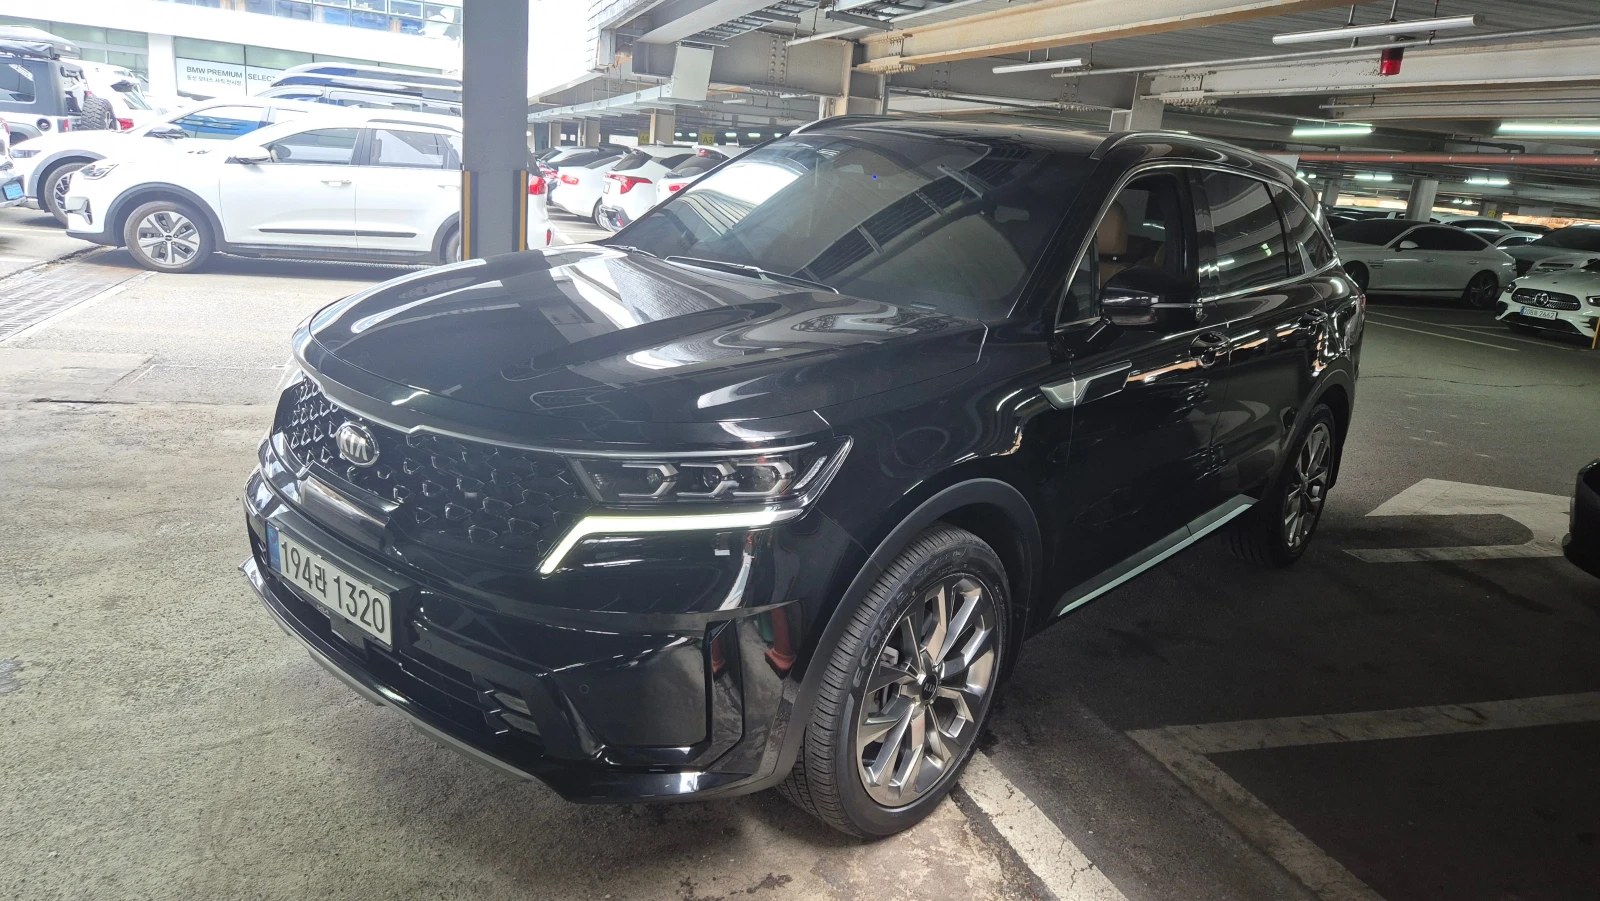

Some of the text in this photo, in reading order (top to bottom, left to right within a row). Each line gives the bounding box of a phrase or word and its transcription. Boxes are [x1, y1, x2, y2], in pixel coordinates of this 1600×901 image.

[187, 66, 205, 74] BMW
[207, 68, 243, 79] PREMIUM
[702, 136, 713, 145] A3
[340, 427, 368, 461] KIA
[281, 541, 385, 634] 194라 1320
